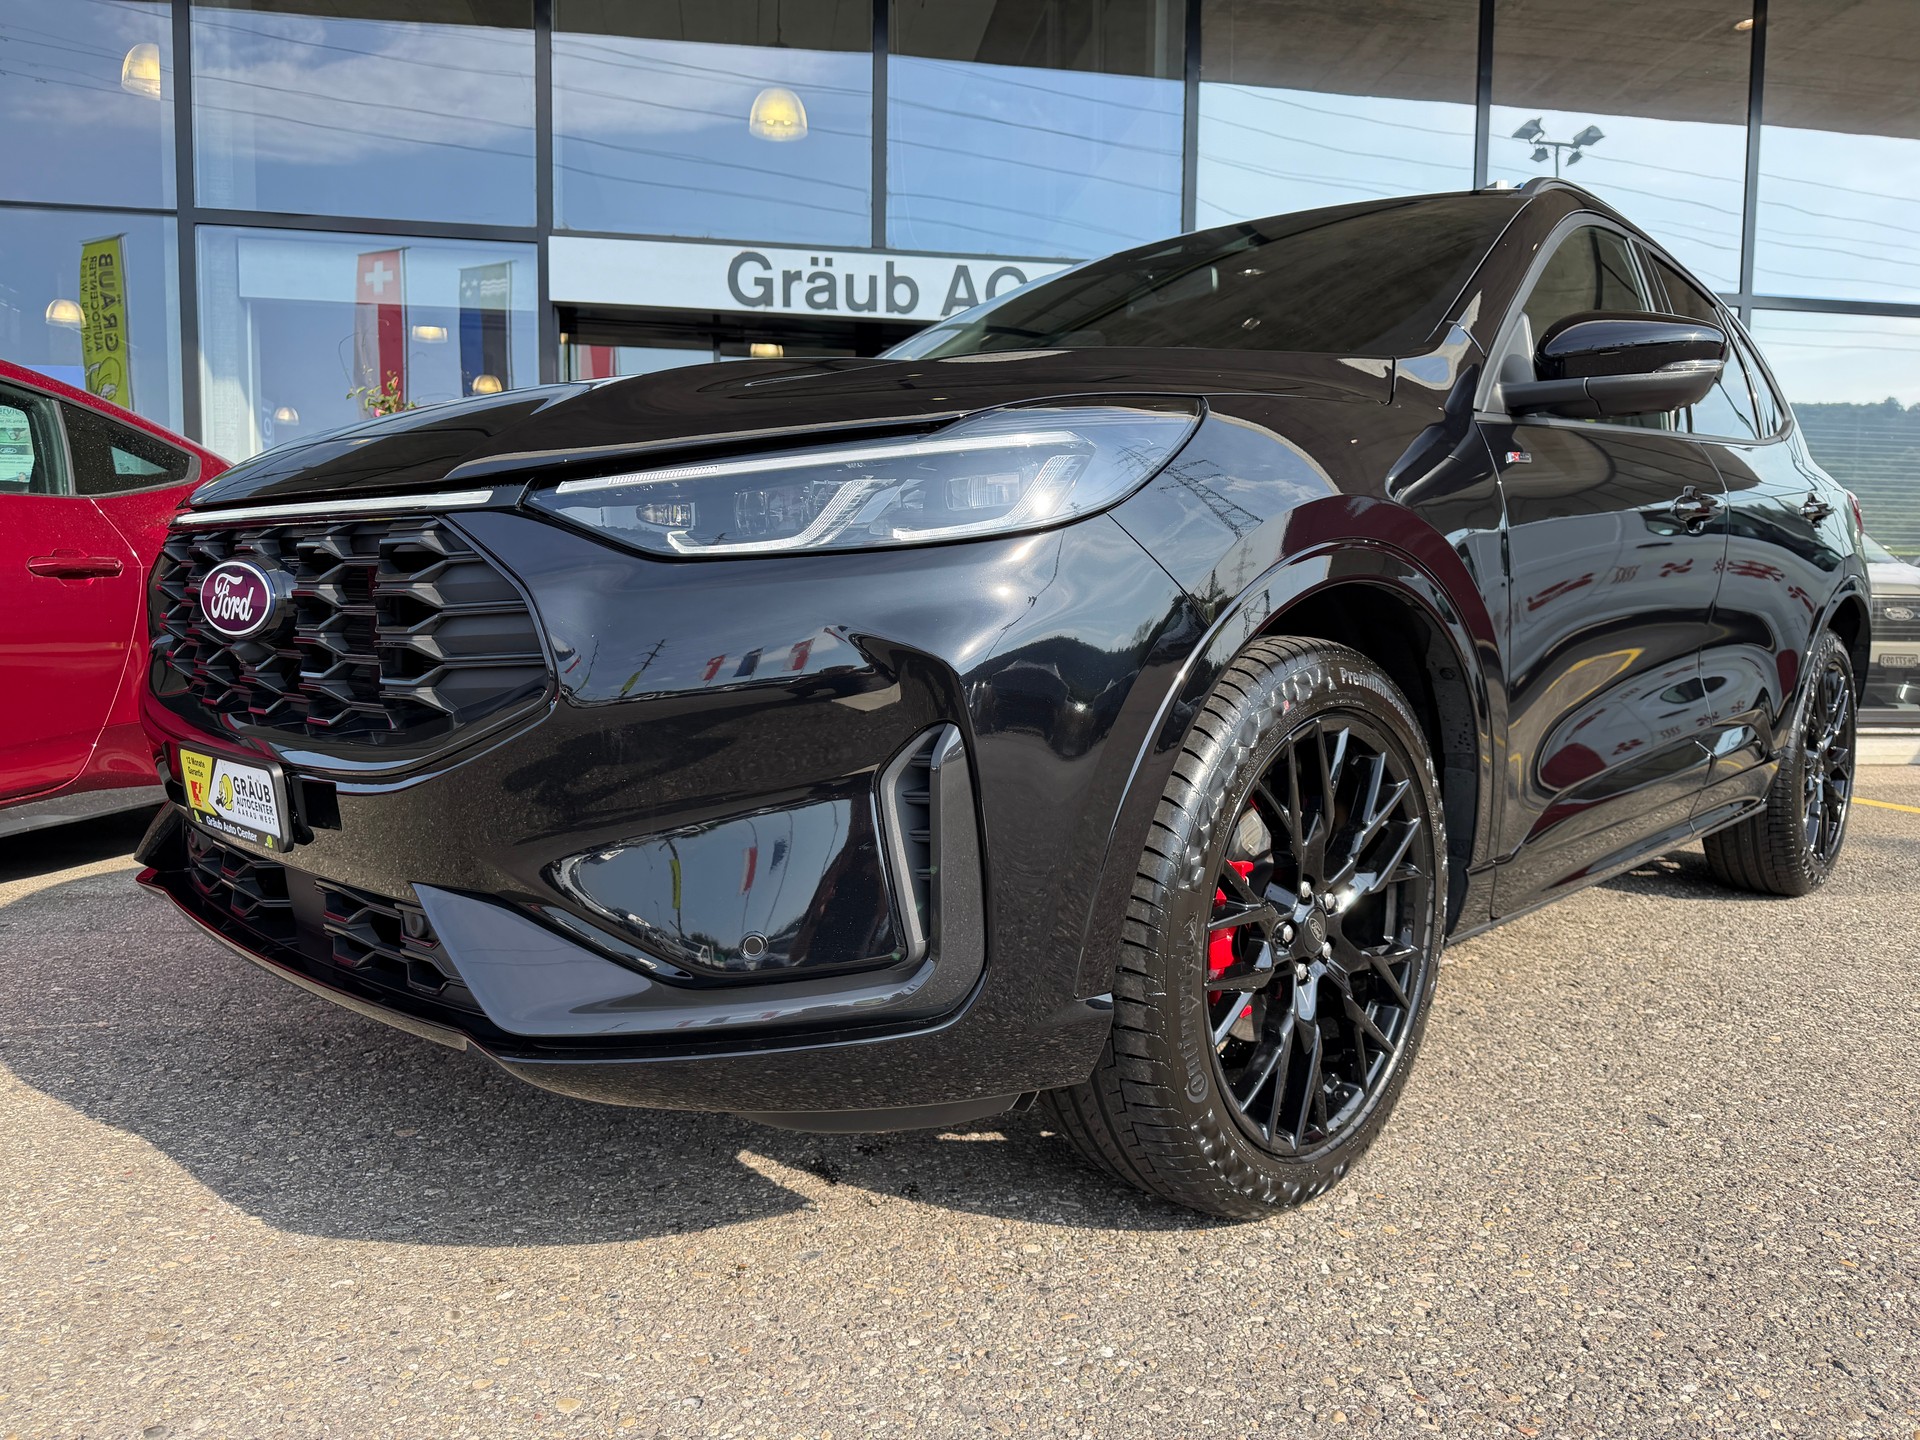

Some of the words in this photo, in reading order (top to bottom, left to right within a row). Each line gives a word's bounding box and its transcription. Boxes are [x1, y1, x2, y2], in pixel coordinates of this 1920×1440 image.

[728, 251, 919, 315] Gräub
[211, 573, 254, 621] Ford
[233, 775, 270, 803] GRÄUB
[237, 796, 273, 815] AUTOCENTER
[238, 809, 256, 819] AARAU
[259, 815, 275, 825] WEST
[206, 815, 222, 830] Gräub
[224, 821, 236, 834] Auto
[237, 826, 257, 842] Center
